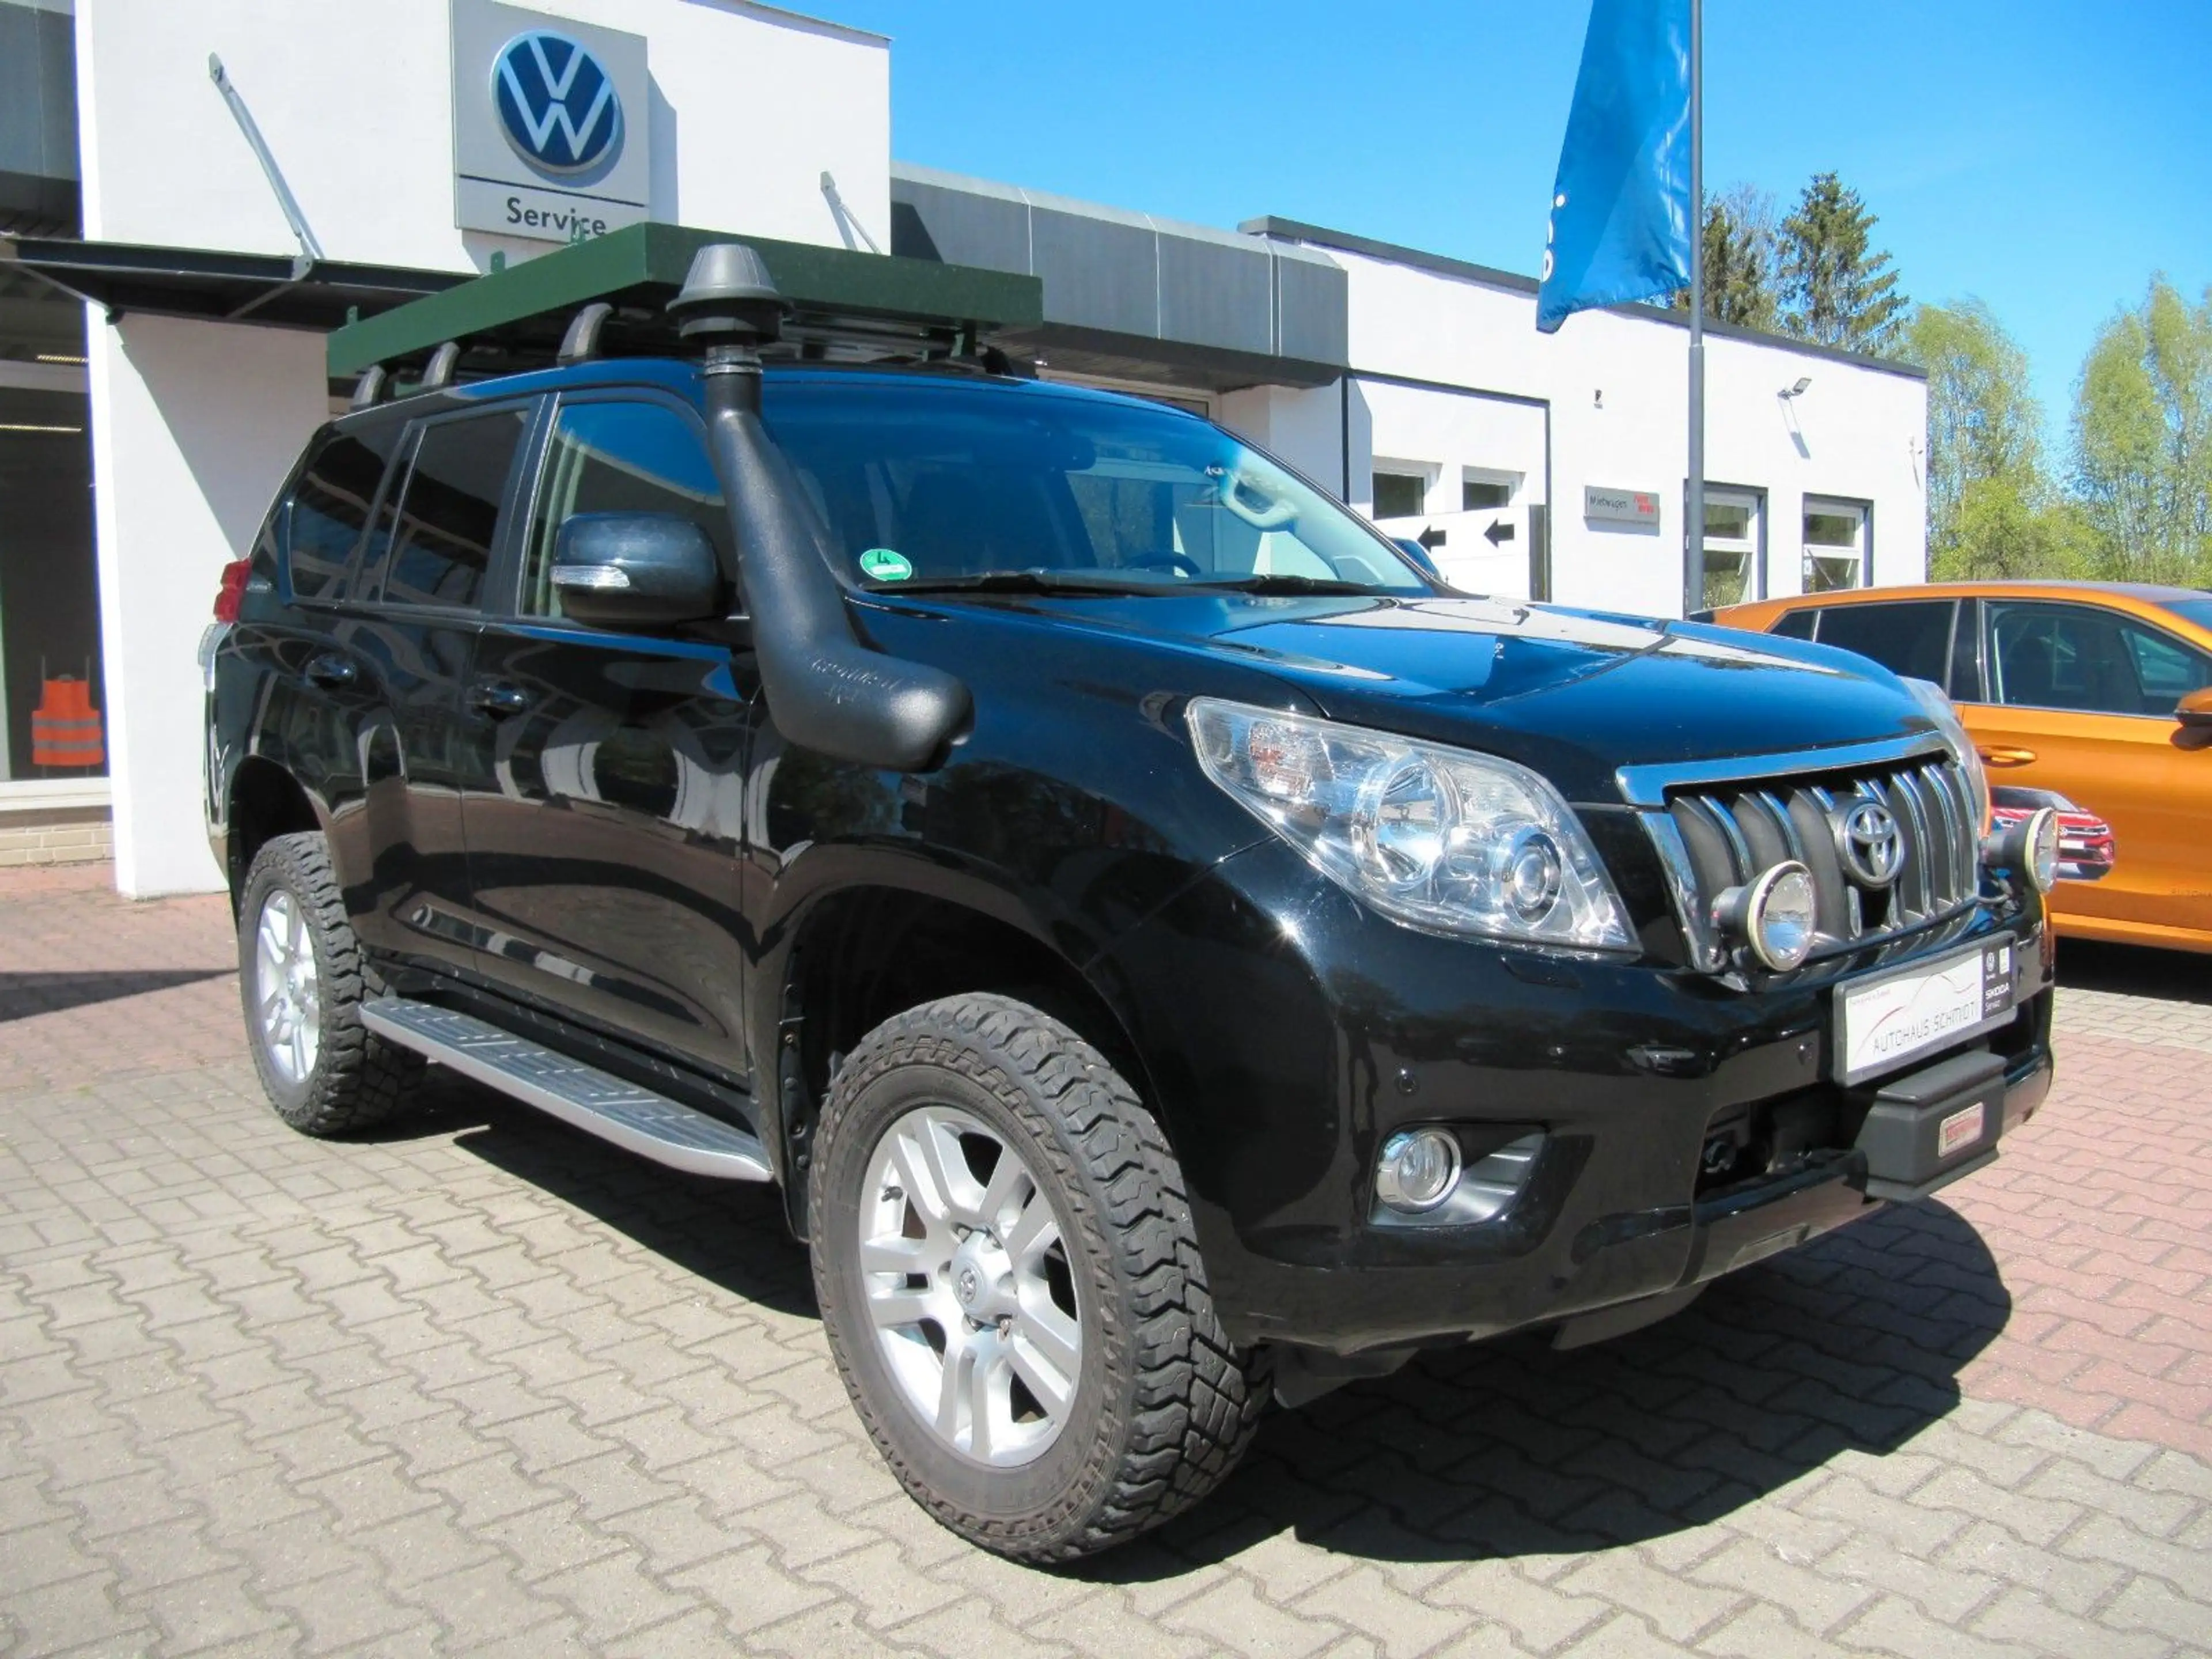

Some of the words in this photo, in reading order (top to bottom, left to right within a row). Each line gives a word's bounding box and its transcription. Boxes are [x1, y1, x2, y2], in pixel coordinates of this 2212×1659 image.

[495, 32, 618, 165] VW
[506, 196, 607, 236] Service
[1873, 1018, 1929, 1054] AUTOHAUS
[1934, 1001, 1978, 1031] SCHMIDT
